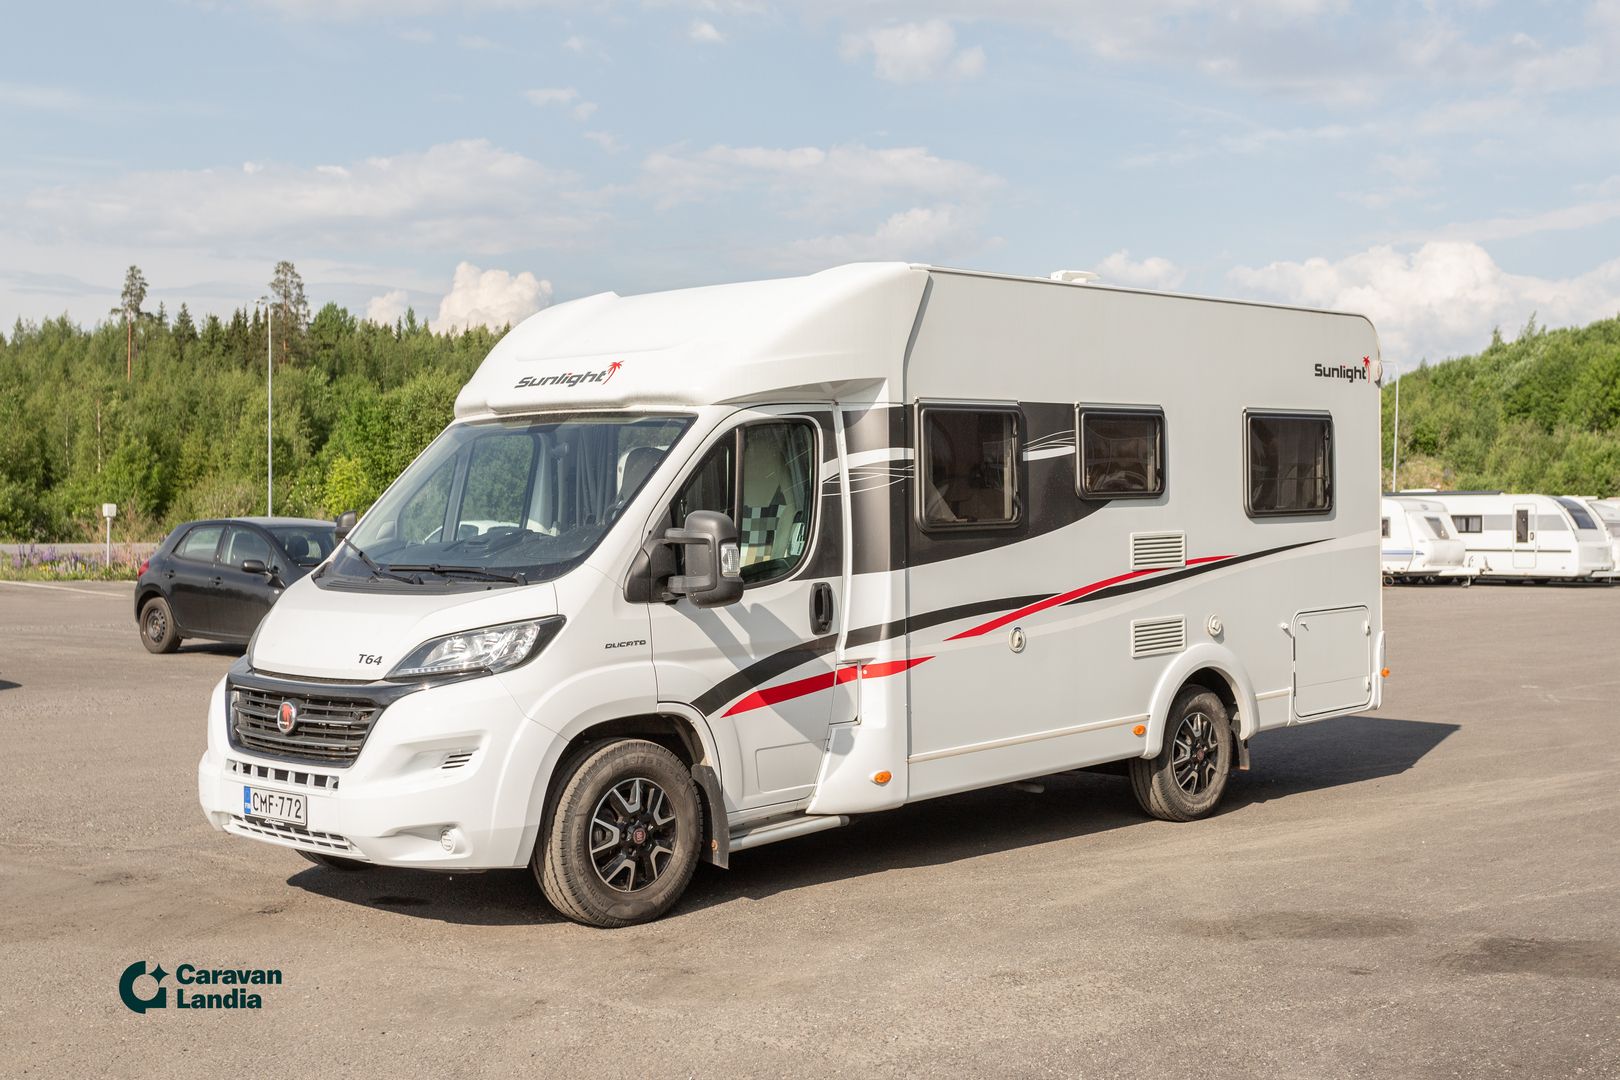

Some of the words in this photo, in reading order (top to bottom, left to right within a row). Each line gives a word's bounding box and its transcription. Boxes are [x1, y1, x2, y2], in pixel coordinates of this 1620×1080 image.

[514, 370, 607, 388] Sunlight
[1314, 363, 1367, 383] Sunlight
[605, 639, 646, 649] DUCATO
[358, 653, 383, 665] T64
[252, 792, 302, 819] CMF-772
